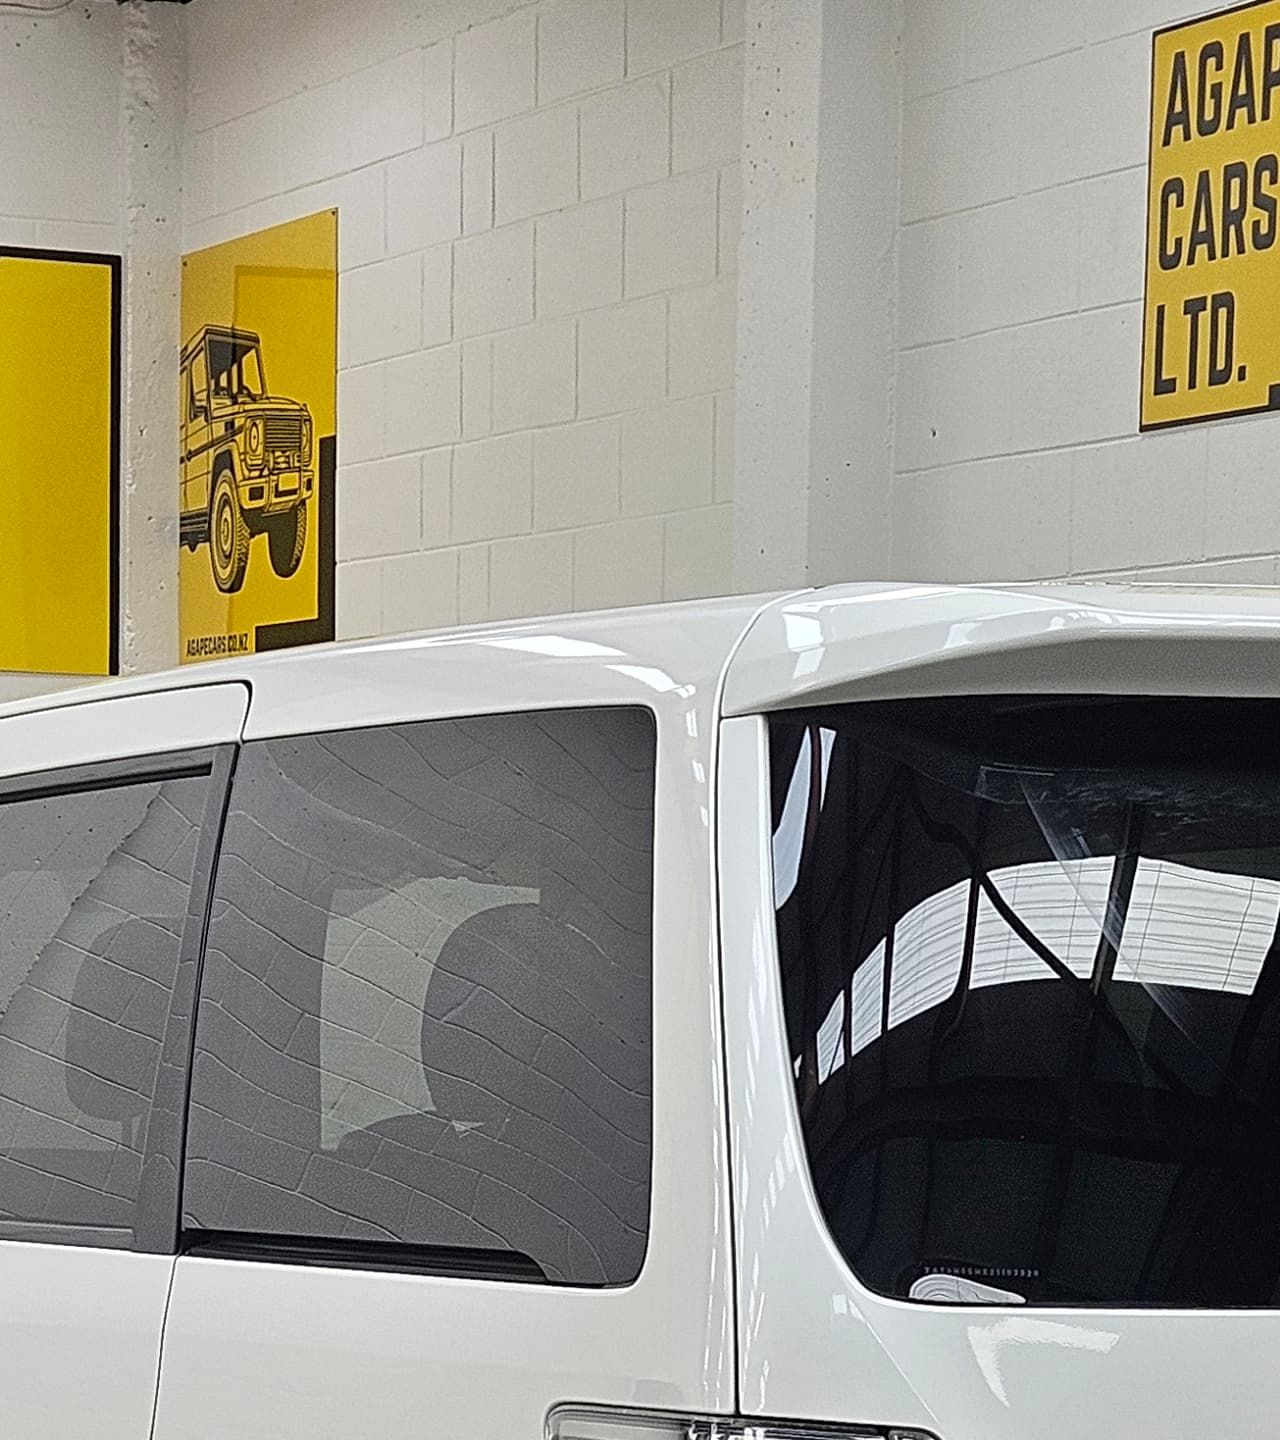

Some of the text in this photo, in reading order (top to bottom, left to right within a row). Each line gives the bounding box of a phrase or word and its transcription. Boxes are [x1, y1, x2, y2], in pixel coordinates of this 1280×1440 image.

[1157, 152, 1280, 272] CARS
[1152, 291, 1247, 396] LTD.
[186, 632, 249, 657] AGAPECARS.CO.NZ
